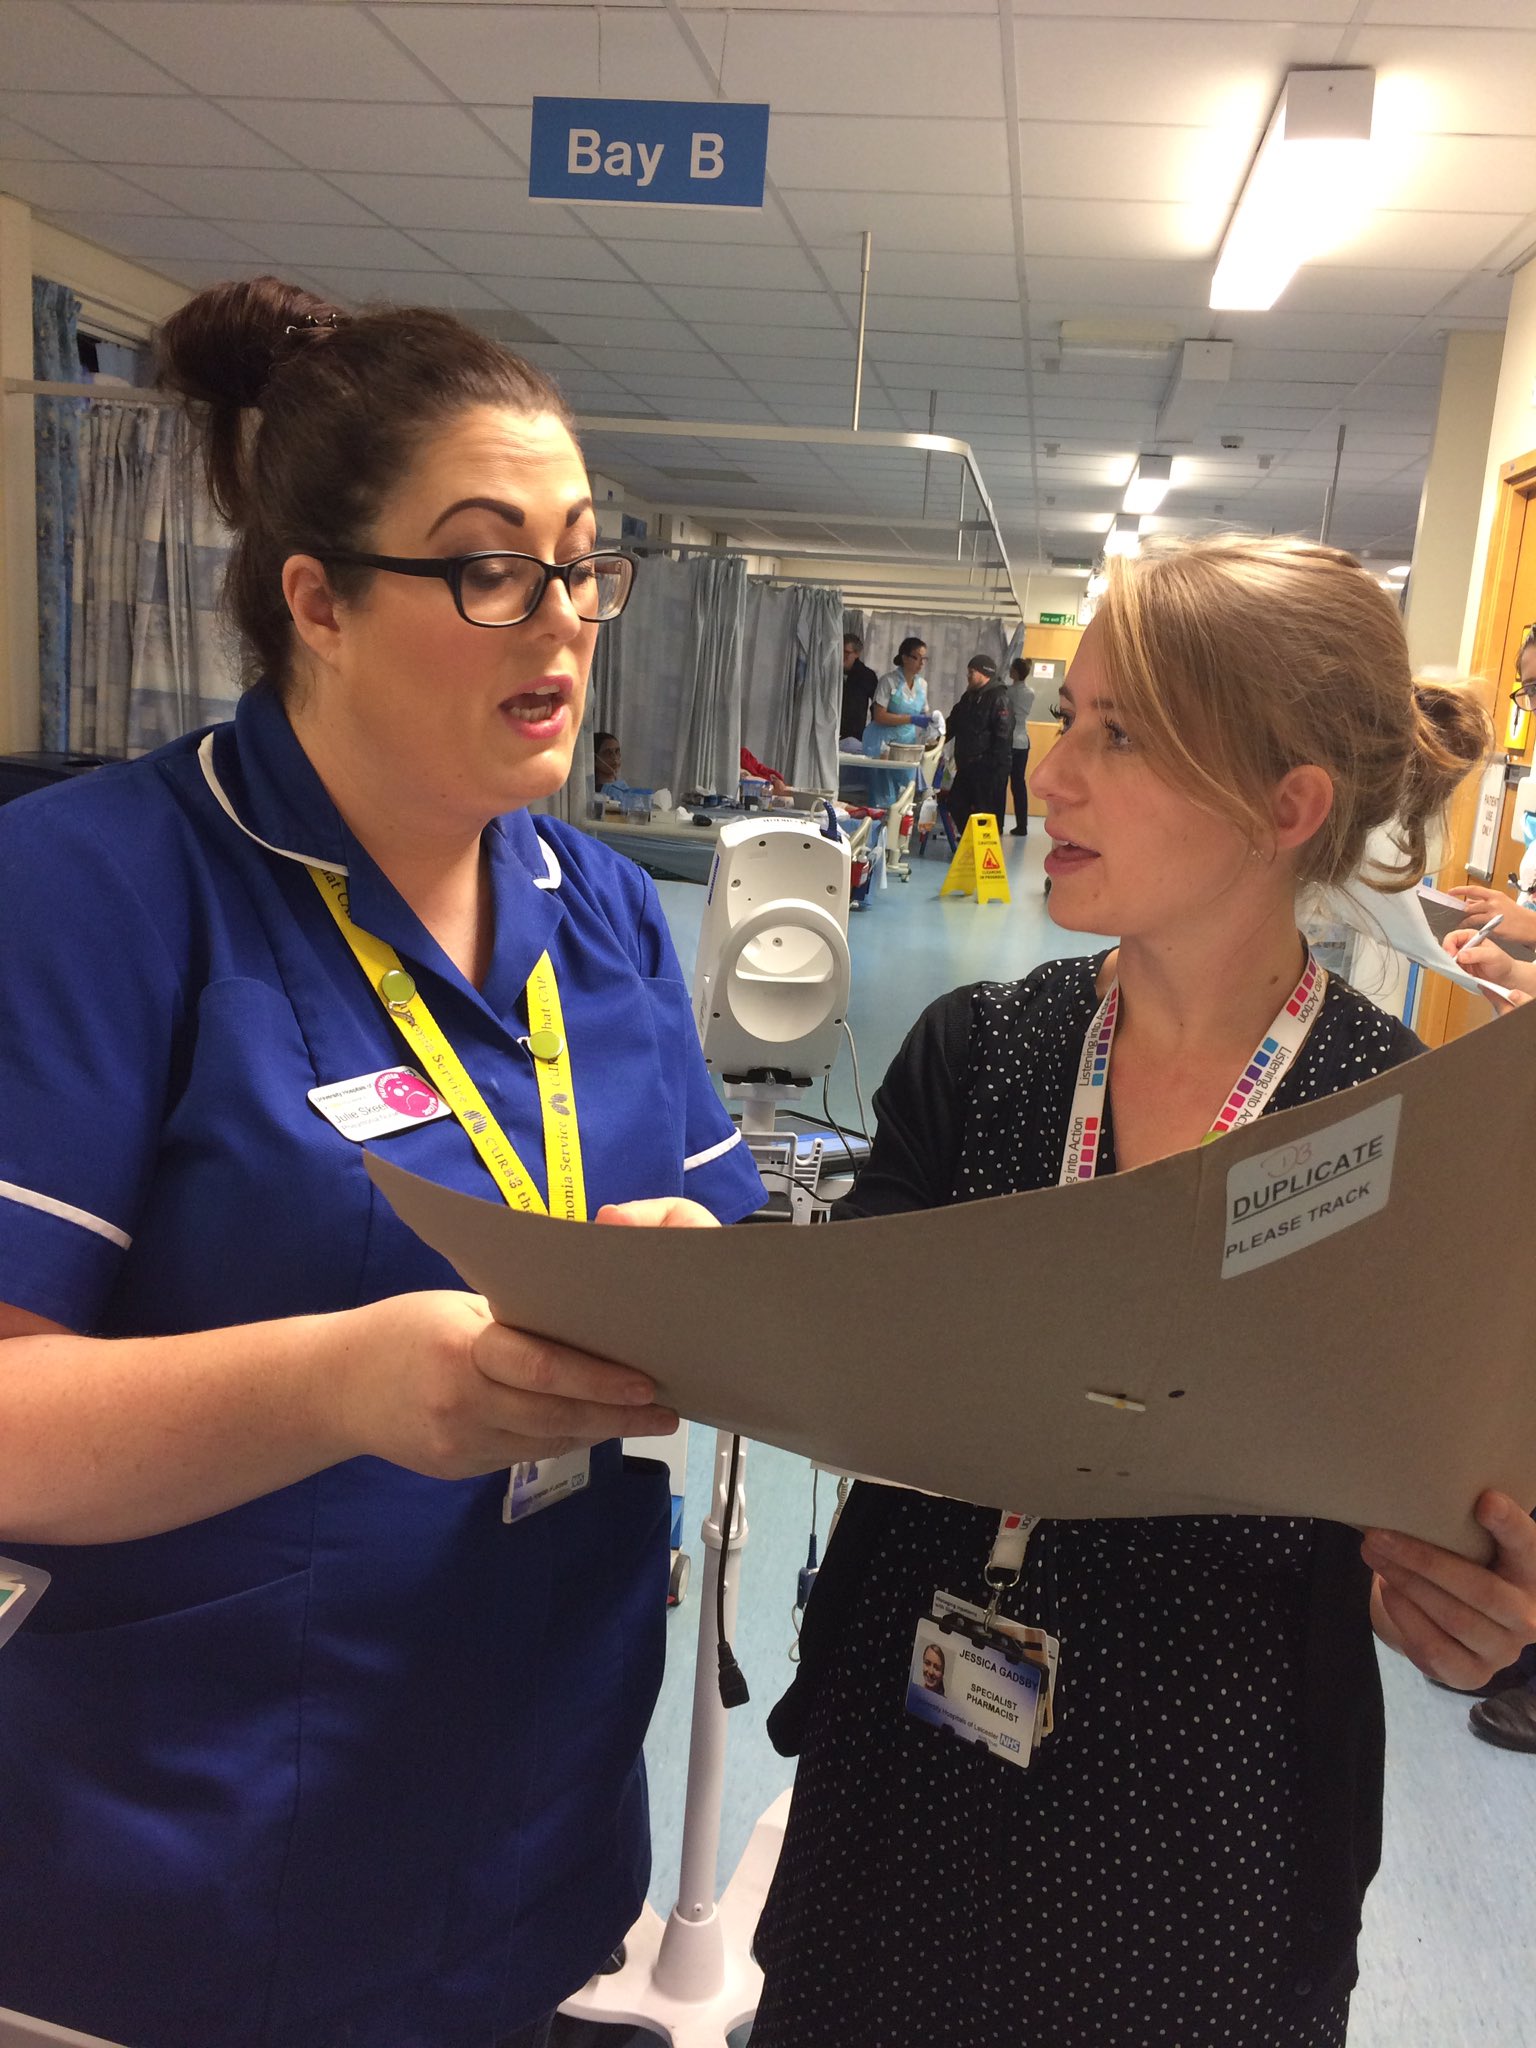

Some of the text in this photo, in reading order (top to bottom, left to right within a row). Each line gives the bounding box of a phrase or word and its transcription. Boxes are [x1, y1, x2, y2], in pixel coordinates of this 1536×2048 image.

[567, 128, 725, 187] Bay B
[1298, 991, 1320, 1024] Action
[1088, 1022, 1102, 1039] into
[1078, 1040, 1099, 1087] Listening
[1255, 1046, 1292, 1090] Listening
[1246, 1087, 1268, 1108] into
[334, 1111, 360, 1123] Julie
[557, 1121, 572, 1172] Service
[1068, 1116, 1084, 1152] Action
[1064, 1153, 1079, 1174] into
[1233, 1134, 1385, 1220] DUPLICATE
[1225, 1182, 1371, 1259] PLEASE TRACK
[959, 1649, 1039, 1691] JESSICA GADSBY
[966, 1692, 1020, 1724] PHARMACIST
[970, 1683, 1018, 1711] SPECIALIST
[942, 1707, 967, 1726] Hospitals
[974, 1723, 999, 1739] Leicester
[1000, 1733, 1020, 1752] NHS
